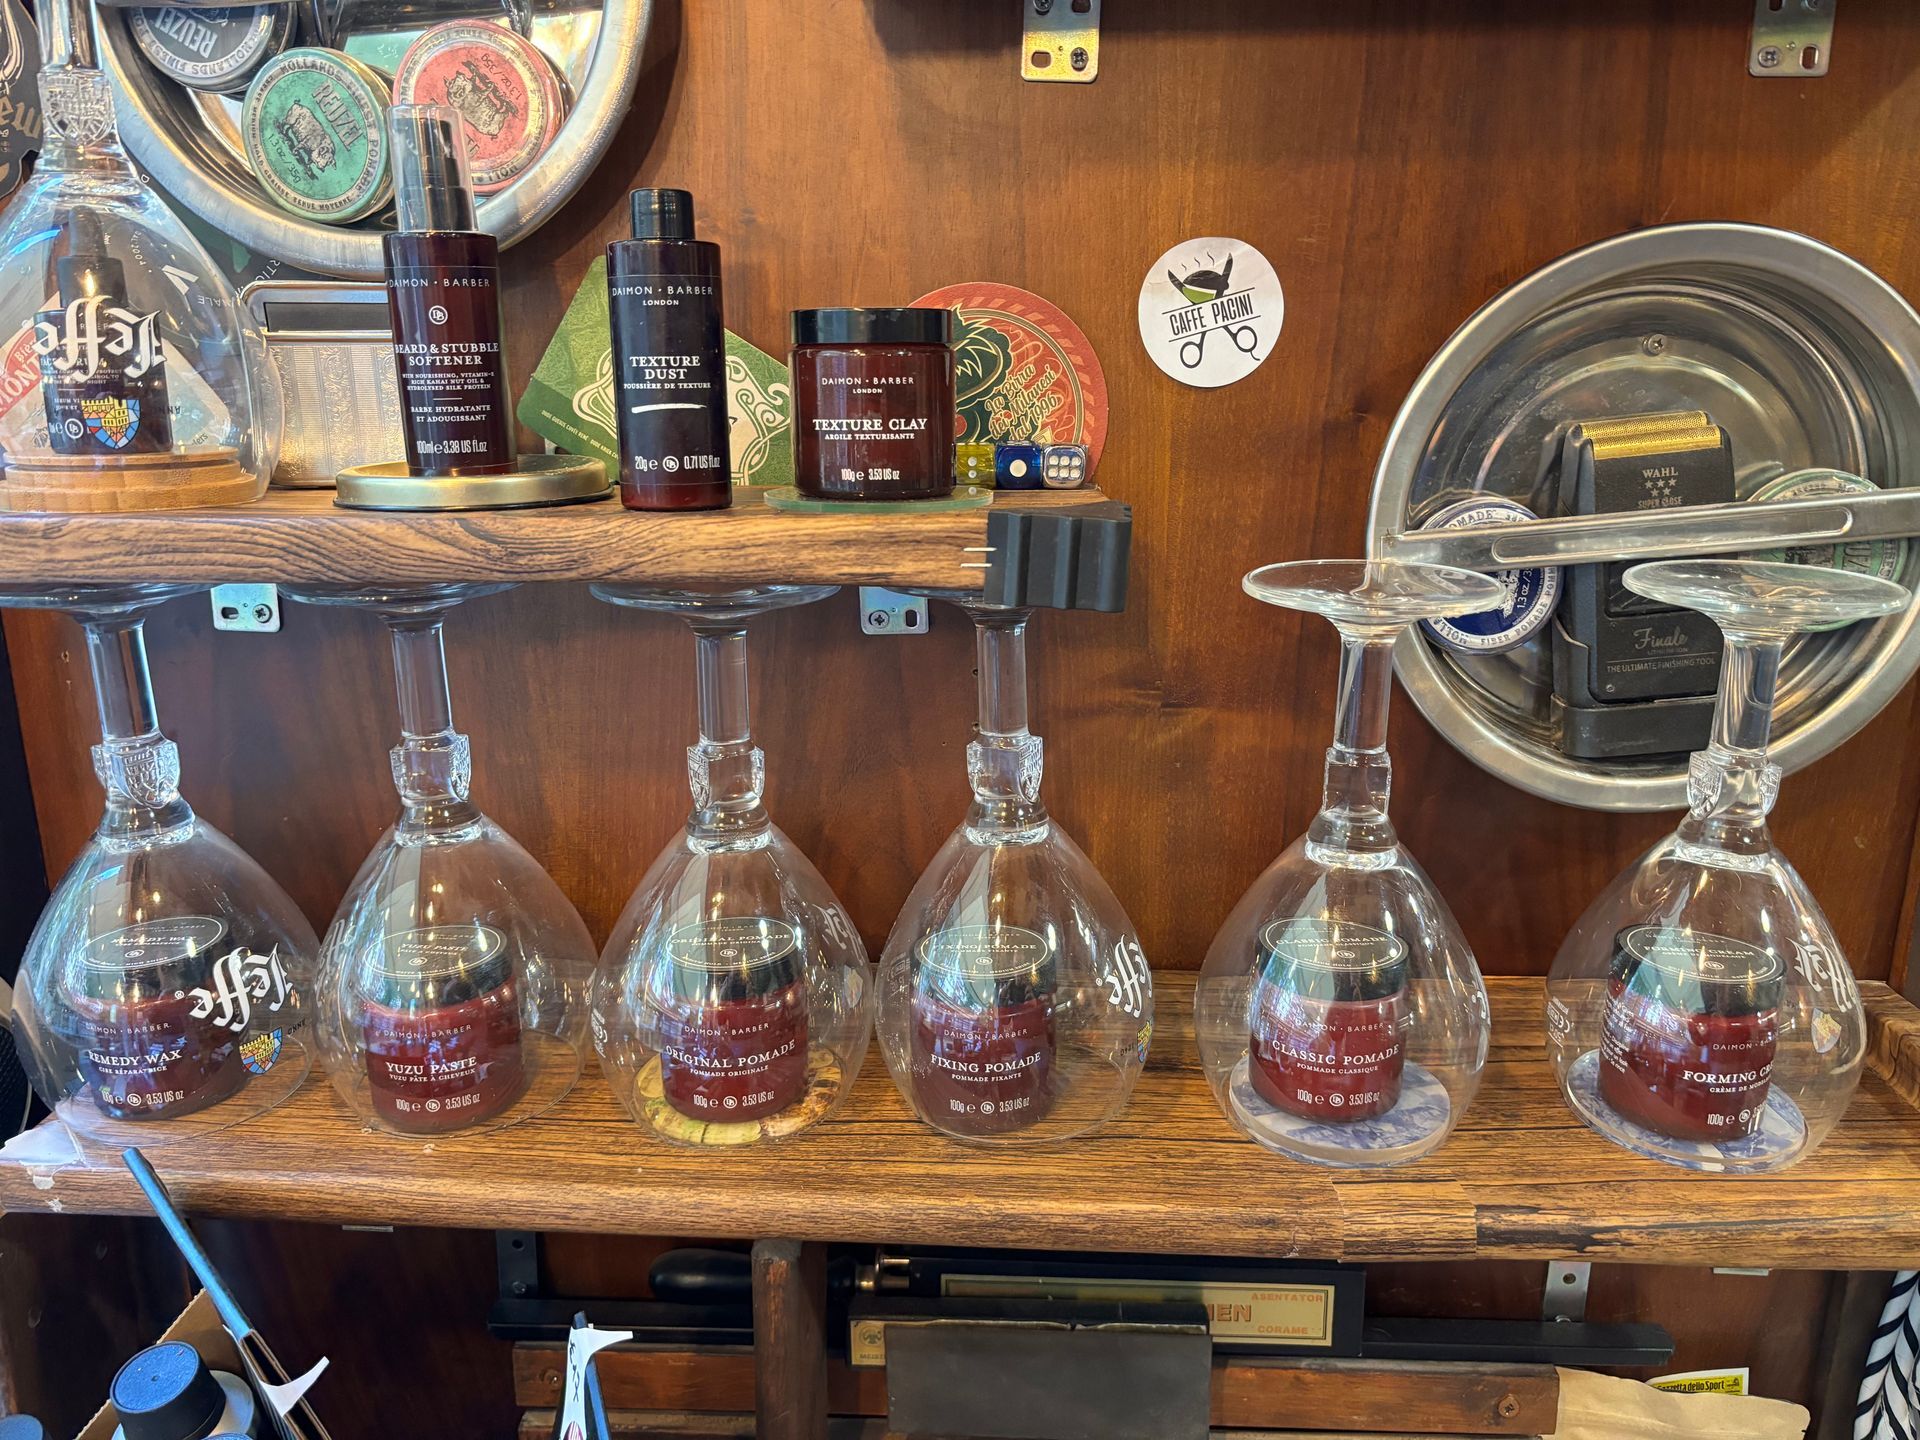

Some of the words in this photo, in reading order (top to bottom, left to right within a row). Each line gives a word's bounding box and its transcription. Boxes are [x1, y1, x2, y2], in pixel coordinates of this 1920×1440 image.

[311, 80, 365, 152] REUZEL
[443, 278, 490, 288] BARBER
[612, 286, 653, 296] DAIMON
[667, 286, 713, 296] BARBER
[1169, 307, 1207, 336] CAFFE
[1211, 293, 1254, 325] PACINI
[32, 295, 168, 383] Leffe
[394, 343, 428, 355] BEARD
[430, 343, 442, 355] &
[443, 342, 499, 354] STUBBLE
[409, 355, 483, 366] SOFTENER
[630, 356, 700, 367] TEXTURE
[644, 368, 687, 380] DUST
[623, 381, 662, 389] POUSSIÈRE
[821, 377, 861, 386] DAIMON
[873, 377, 914, 385] BARBER
[984, 396, 1005, 416] La
[1001, 364, 1036, 400] Birra
[435, 405, 491, 413] HYDRATANTE
[989, 411, 1010, 439] dei
[1009, 365, 1057, 425] Milanesi
[427, 415, 487, 423] ADOUCISSANT
[1009, 416, 1032, 440] dal
[1029, 391, 1058, 425] 1996
[813, 419, 883, 431] TEXTURE
[888, 418, 928, 430] CLAY
[443, 440, 460, 454] 3.38
[460, 440, 471, 454] US
[635, 456, 648, 472] 20g
[684, 456, 698, 469] 0.71
[699, 455, 708, 469] US
[841, 468, 856, 482] 100g
[868, 468, 883, 481] 3.53
[883, 468, 892, 481] US
[893, 470, 900, 480] oz
[1642, 466, 1679, 478] WAHL
[1661, 496, 1682, 507] CLOSE
[1480, 634, 1512, 646] FIBER
[1514, 601, 1549, 636] POMADE
[1633, 626, 1689, 649] Finale
[1607, 665, 1620, 673] THE
[1622, 662, 1657, 672] ULTIMATE
[1658, 658, 1695, 669] FINISHING
[1696, 657, 1716, 666] TOOL
[188, 943, 293, 1033] Leffe
[127, 1022, 170, 1034] BARBER
[384, 1030, 420, 1039] DAIMON
[431, 1024, 472, 1038] BARBER
[684, 1025, 721, 1036] DAIMON
[731, 1022, 769, 1035] BARBER
[1295, 1017, 1336, 1032] DAIMON
[1347, 1022, 1384, 1032] BARBER
[944, 1029, 981, 1040] DAIMON
[991, 1028, 1028, 1040] BARBER
[88, 1049, 140, 1066] REMEDY
[144, 1049, 182, 1064] WAX
[666, 1045, 732, 1068] ORIGINAL
[738, 1039, 795, 1067] POMADE
[1272, 1040, 1336, 1065] CLASSIC
[1343, 1044, 1399, 1065] POMADE
[385, 1061, 424, 1075] YUZU
[430, 1056, 477, 1075] PASTE
[930, 1053, 980, 1073] FIXING
[984, 1051, 1041, 1073] POMADE
[1296, 1062, 1336, 1074] POMMADE
[1338, 1065, 1378, 1074] CLASSIQUE
[115, 1065, 168, 1075] RÉPARATRICE
[410, 1074, 428, 1082] PÂTE
[439, 1068, 476, 1081] CHEVEUX
[690, 1068, 726, 1077] POMMADE
[728, 1065, 769, 1077] ORIGINALE
[951, 1073, 989, 1082] POMMADE
[991, 1072, 1022, 1082] FIXANTE
[1682, 1070, 1757, 1084] FORMING
[145, 1092, 163, 1105] 3.53
[163, 1090, 175, 1103] US
[176, 1090, 184, 1100] oz
[395, 1098, 410, 1112] 100g
[445, 1096, 461, 1110] 3.53
[461, 1094, 472, 1107] US
[472, 1093, 480, 1104] oz
[693, 1094, 708, 1108] 100g
[742, 1095, 757, 1107] 3.53
[757, 1091, 767, 1105] US
[767, 1090, 775, 1101] oz
[1297, 1088, 1312, 1104] 100g
[1348, 1094, 1364, 1106] 3.53
[1364, 1092, 1373, 1104] US
[1373, 1092, 1380, 1102] oz
[950, 1099, 964, 1113] 100g
[999, 1100, 1014, 1113] 3.53
[1014, 1097, 1023, 1110] US
[1023, 1097, 1030, 1107] oz
[1707, 1113, 1724, 1126] 100g
[1251, 1293, 1323, 1302] ASENTATOR
[1257, 1325, 1309, 1335] CORAME
[1688, 1381, 1705, 1391] dello
[1705, 1380, 1725, 1391] Sport
